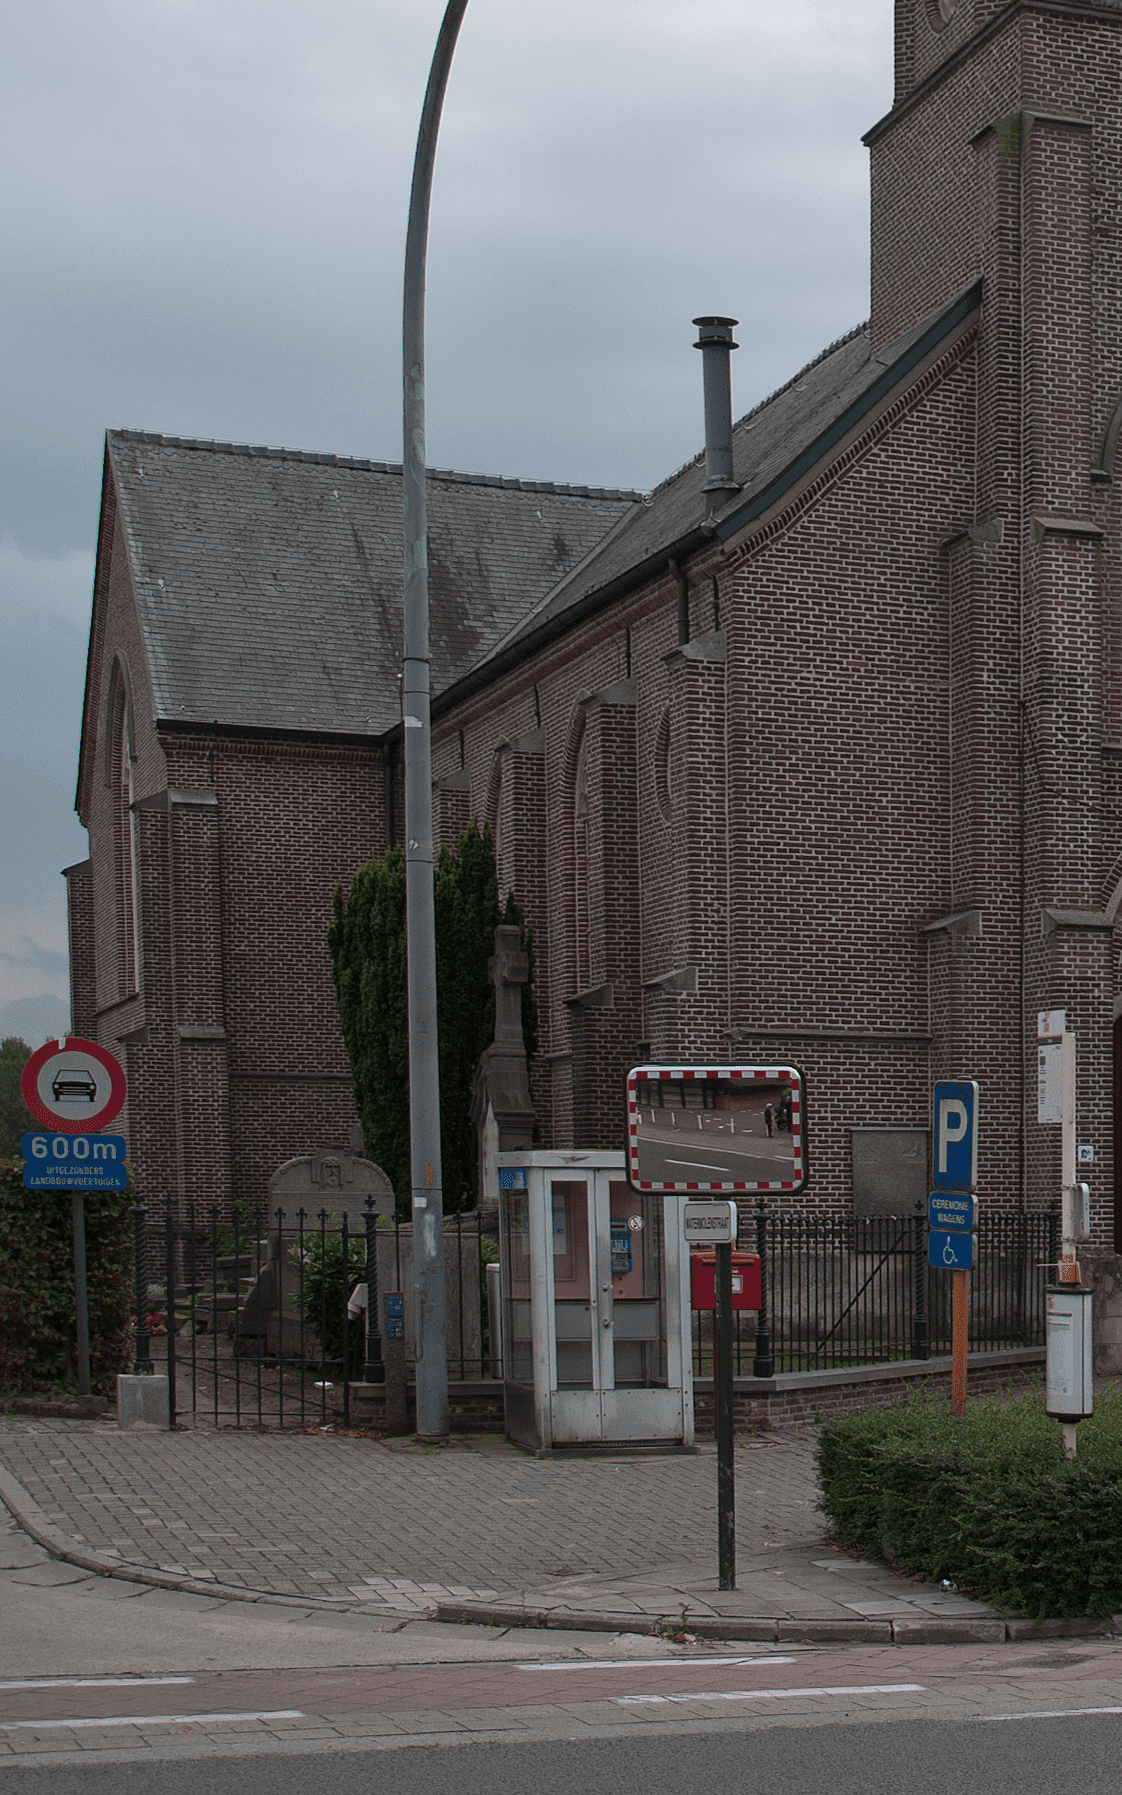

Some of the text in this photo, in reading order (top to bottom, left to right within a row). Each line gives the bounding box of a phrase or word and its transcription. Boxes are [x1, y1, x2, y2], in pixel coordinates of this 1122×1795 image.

[939, 1098, 968, 1173] P
[31, 1136, 117, 1159] 600m
[931, 1198, 971, 1211] CEREMONIE-
[937, 1212, 965, 1225] WAGENS
